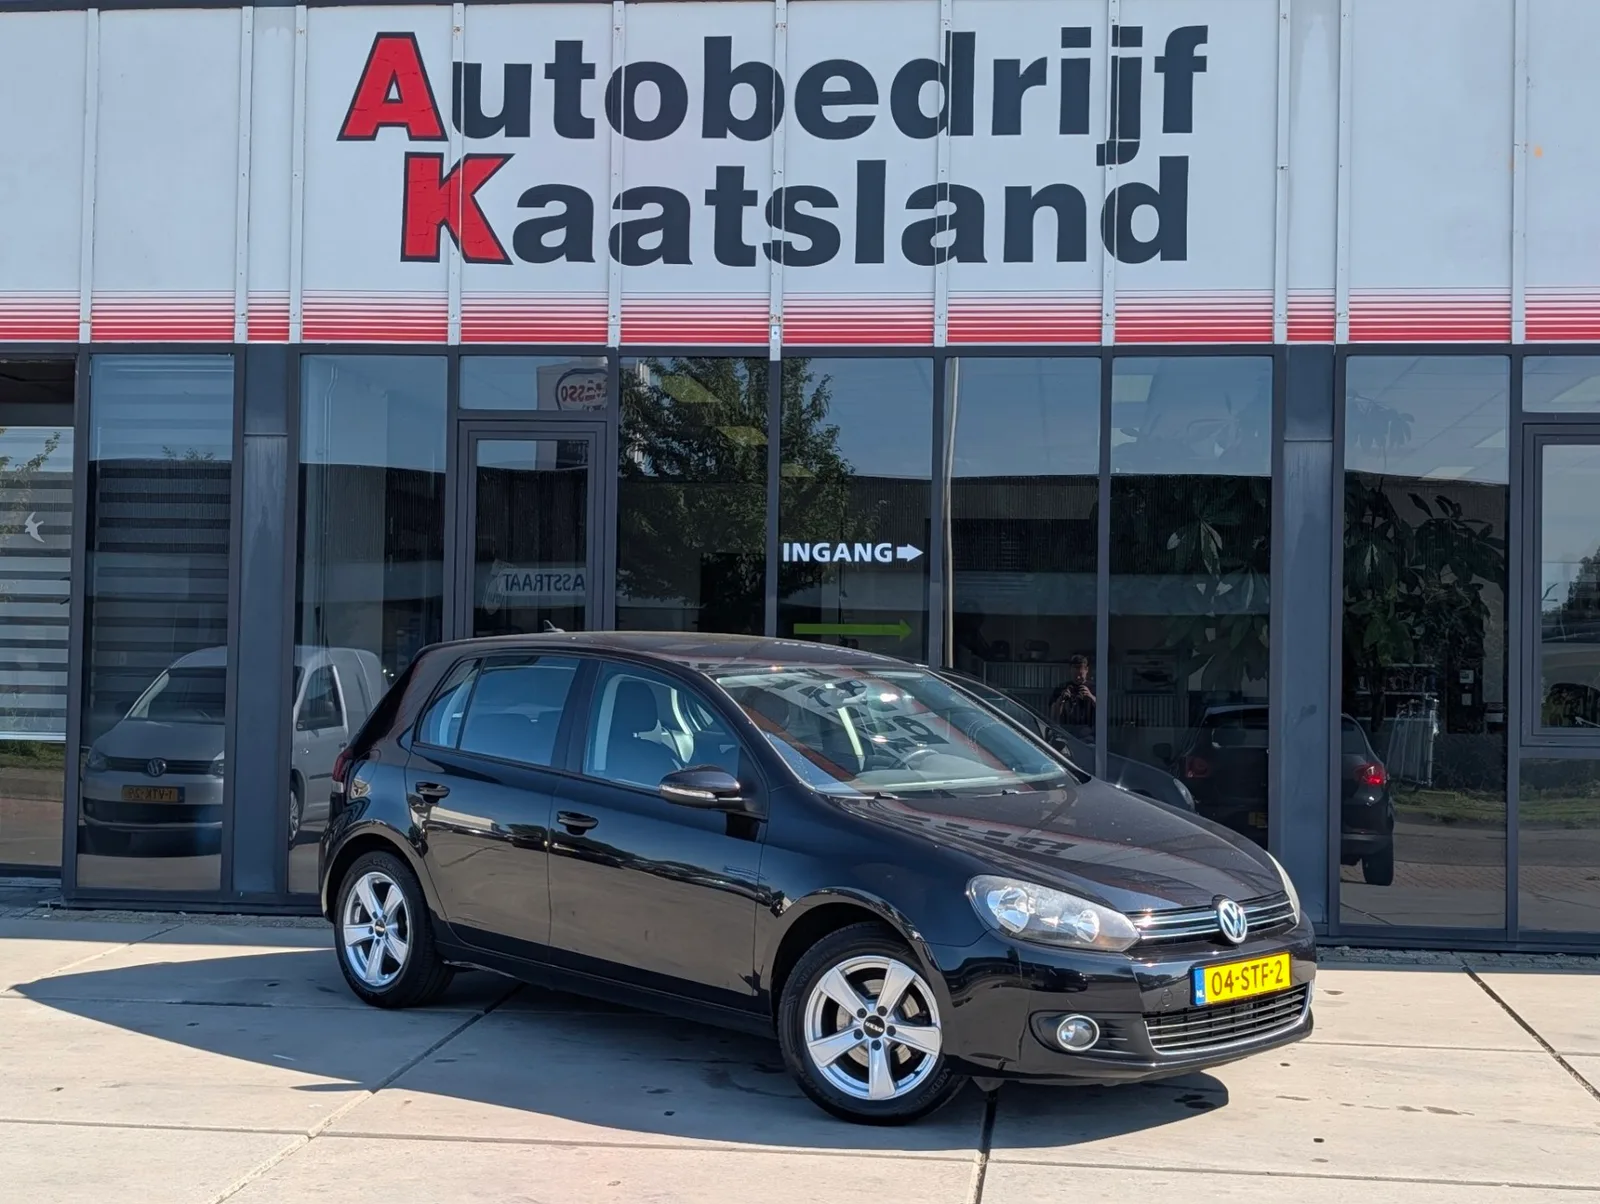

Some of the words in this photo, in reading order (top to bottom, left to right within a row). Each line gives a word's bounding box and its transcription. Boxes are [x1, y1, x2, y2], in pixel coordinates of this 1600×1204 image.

[337, 25, 1209, 167] Autobedrijf
[400, 151, 1189, 267] Kaatsland
[783, 542, 893, 563] INGANG
[1211, 959, 1283, 996] 04-STF-2
